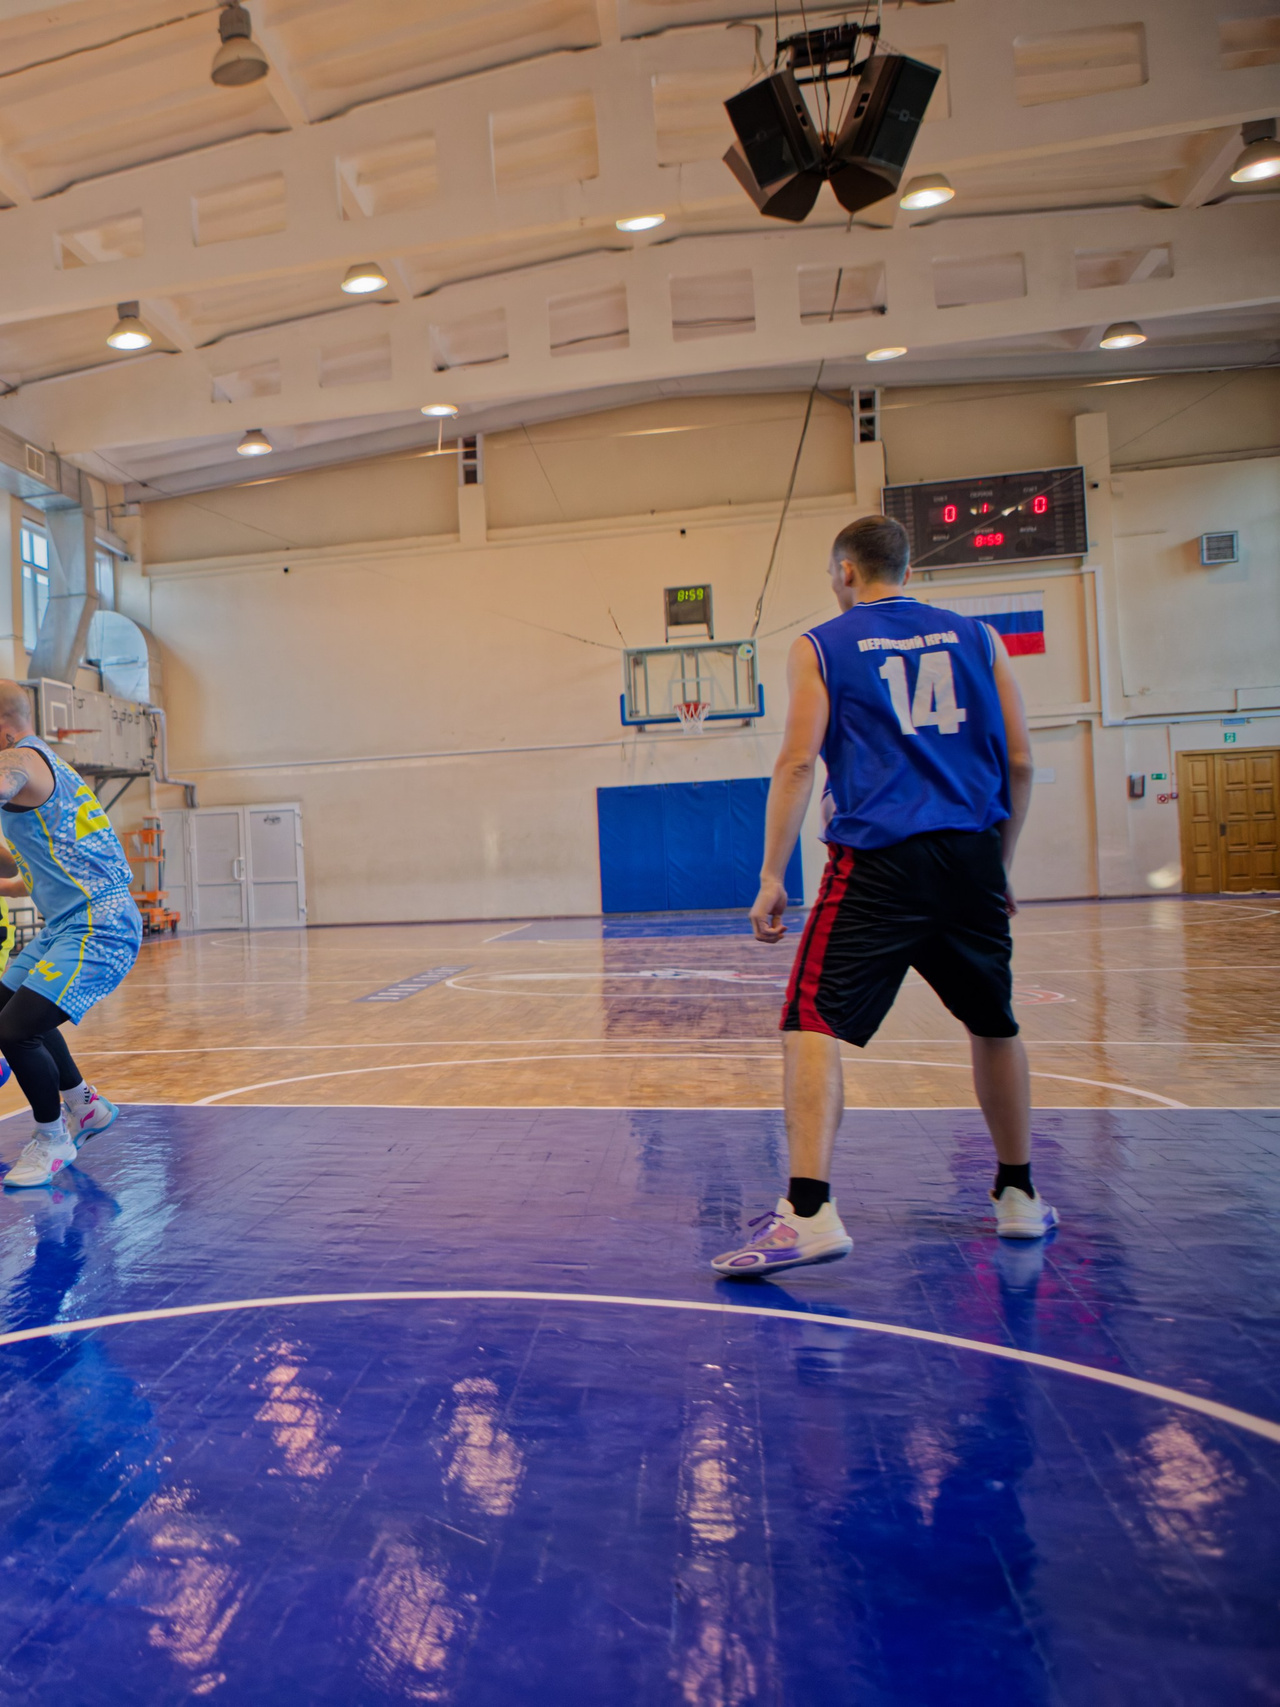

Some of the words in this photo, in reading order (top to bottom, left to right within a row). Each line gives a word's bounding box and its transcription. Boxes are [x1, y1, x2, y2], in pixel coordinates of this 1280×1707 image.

[982, 502, 989, 514] 1
[1033, 496, 1048, 514] 0
[943, 504, 958, 523] 0
[974, 532, 1004, 547] 8:59
[677, 587, 704, 602] 8:59
[879, 650, 966, 735] 14
